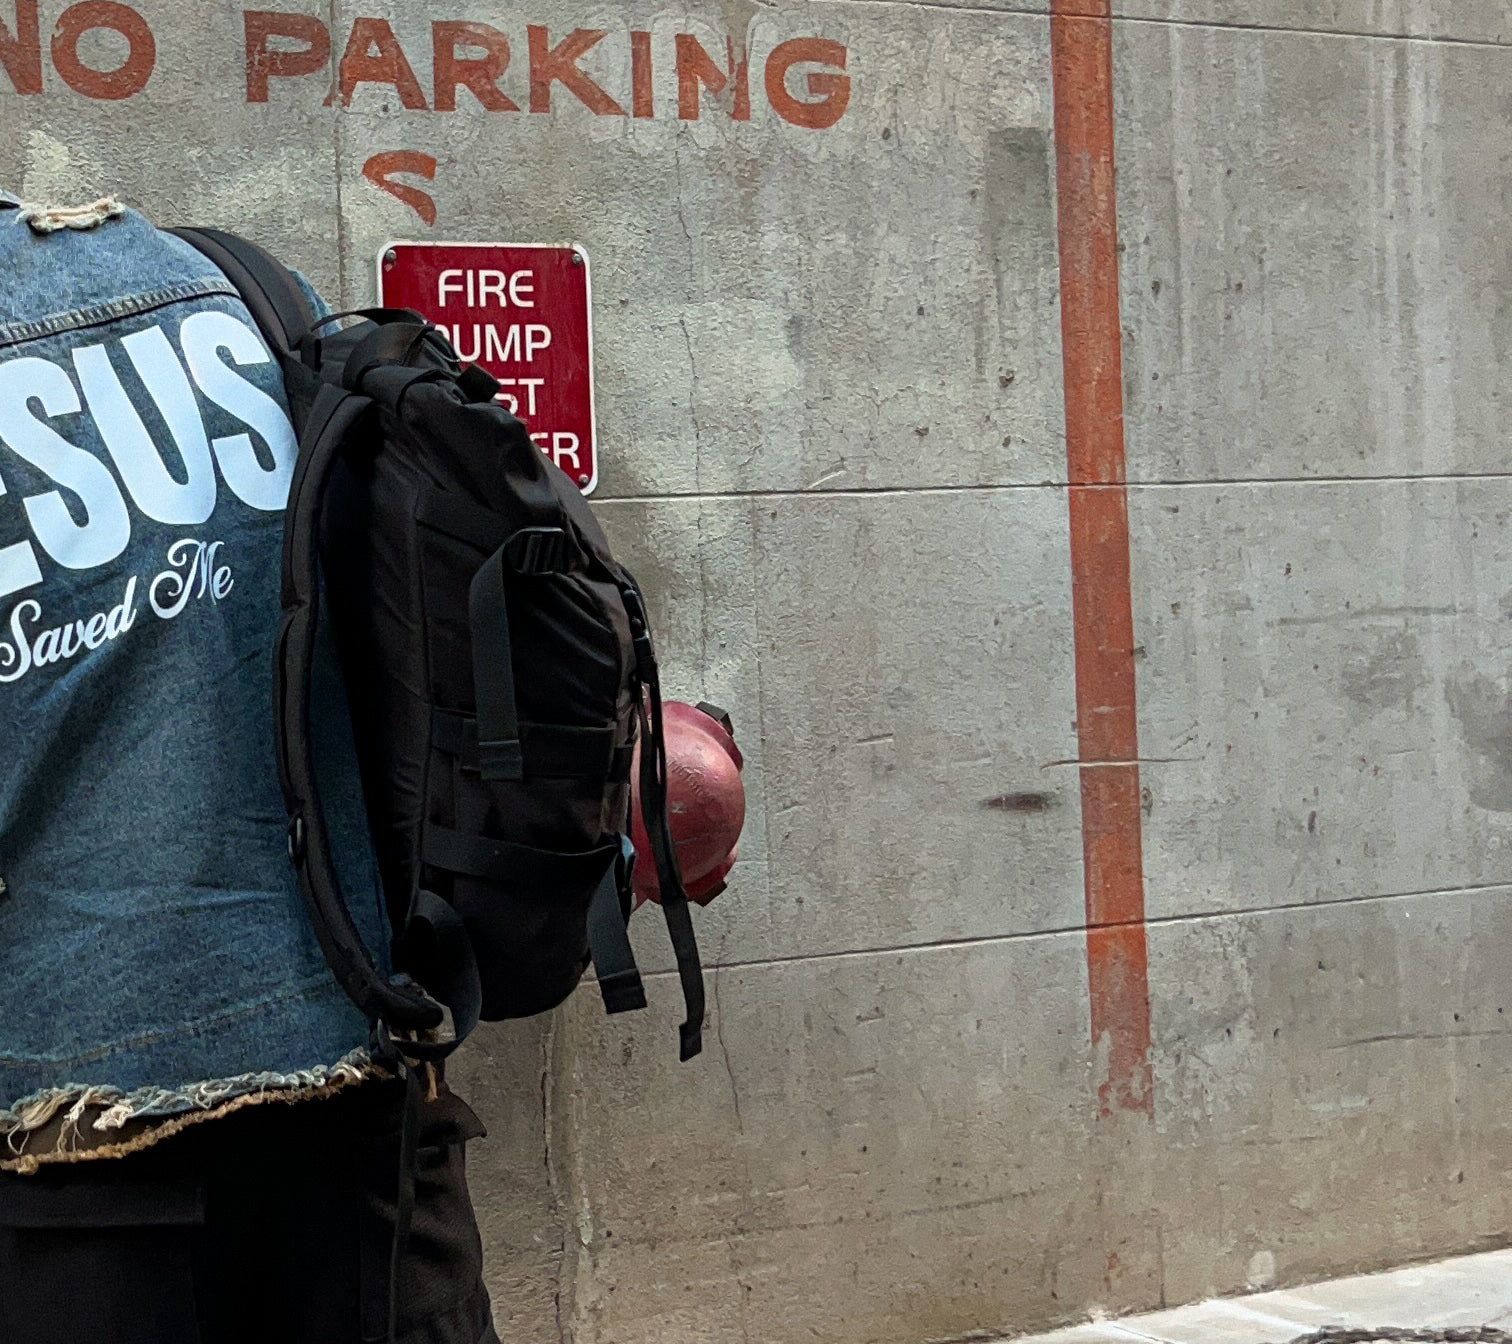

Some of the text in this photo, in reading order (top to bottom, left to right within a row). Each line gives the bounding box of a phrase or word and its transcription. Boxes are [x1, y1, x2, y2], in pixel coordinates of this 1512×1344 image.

[242, 8, 851, 130] PARKING
[437, 268, 535, 308] FIRE
[148, 538, 234, 620] Me
